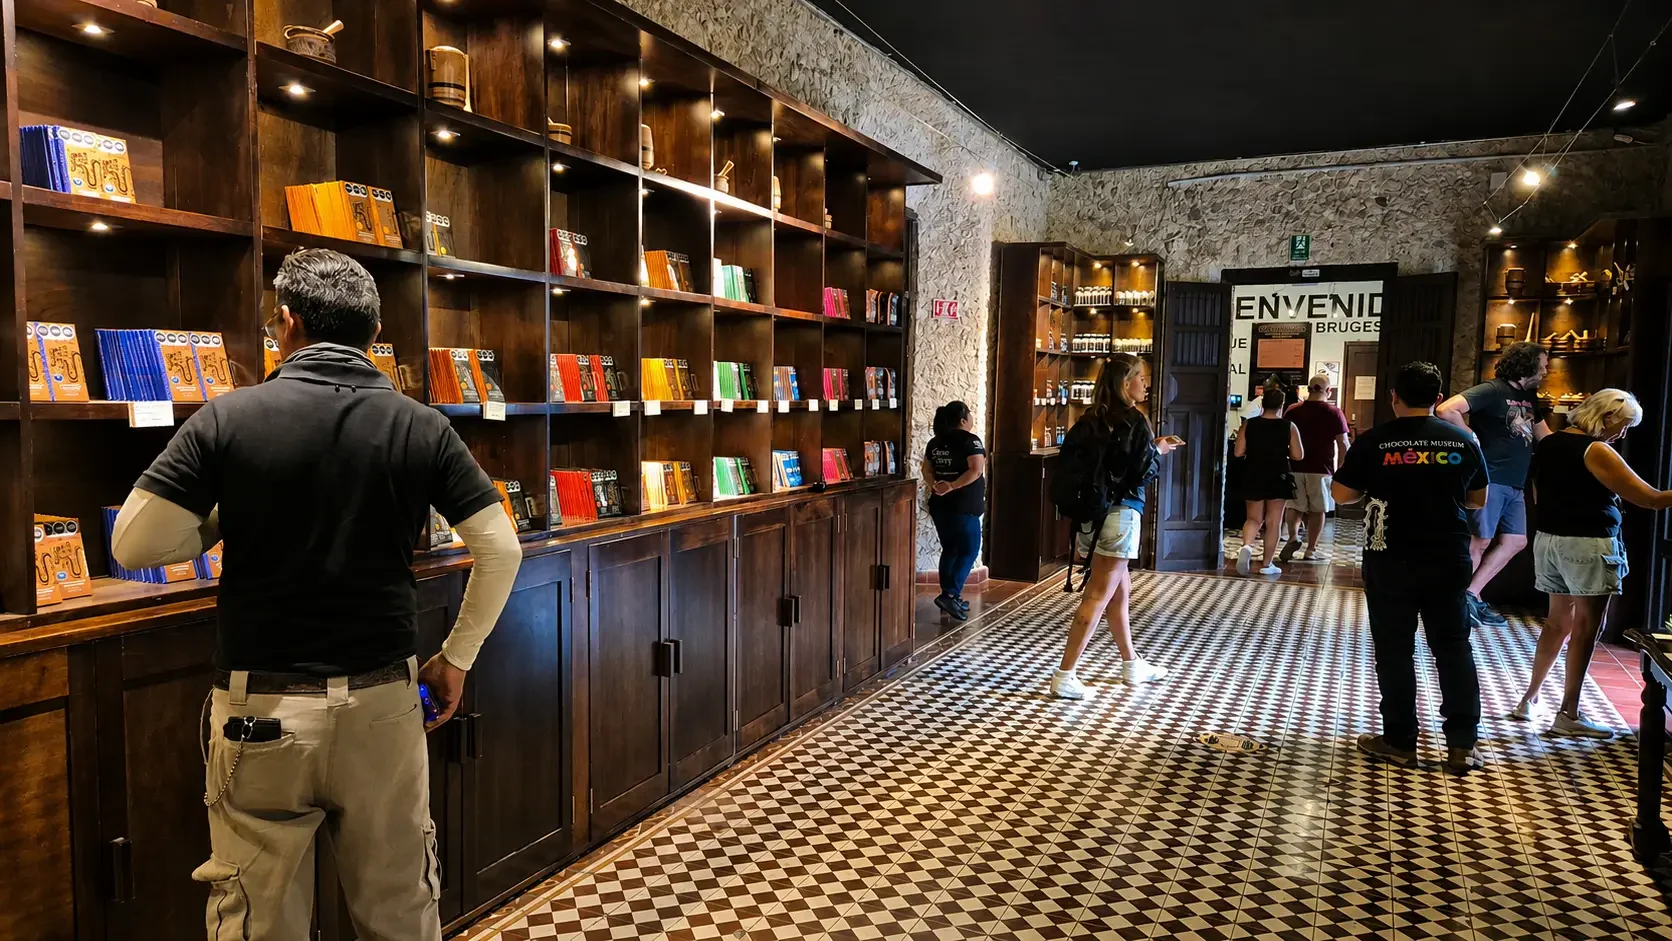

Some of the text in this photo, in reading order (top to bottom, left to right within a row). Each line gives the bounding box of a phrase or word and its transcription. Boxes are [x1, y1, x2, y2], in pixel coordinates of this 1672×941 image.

[1316, 321, 1381, 333] BRUGES
[1379, 440, 1465, 449] CHOCOLATE MUSEUM
